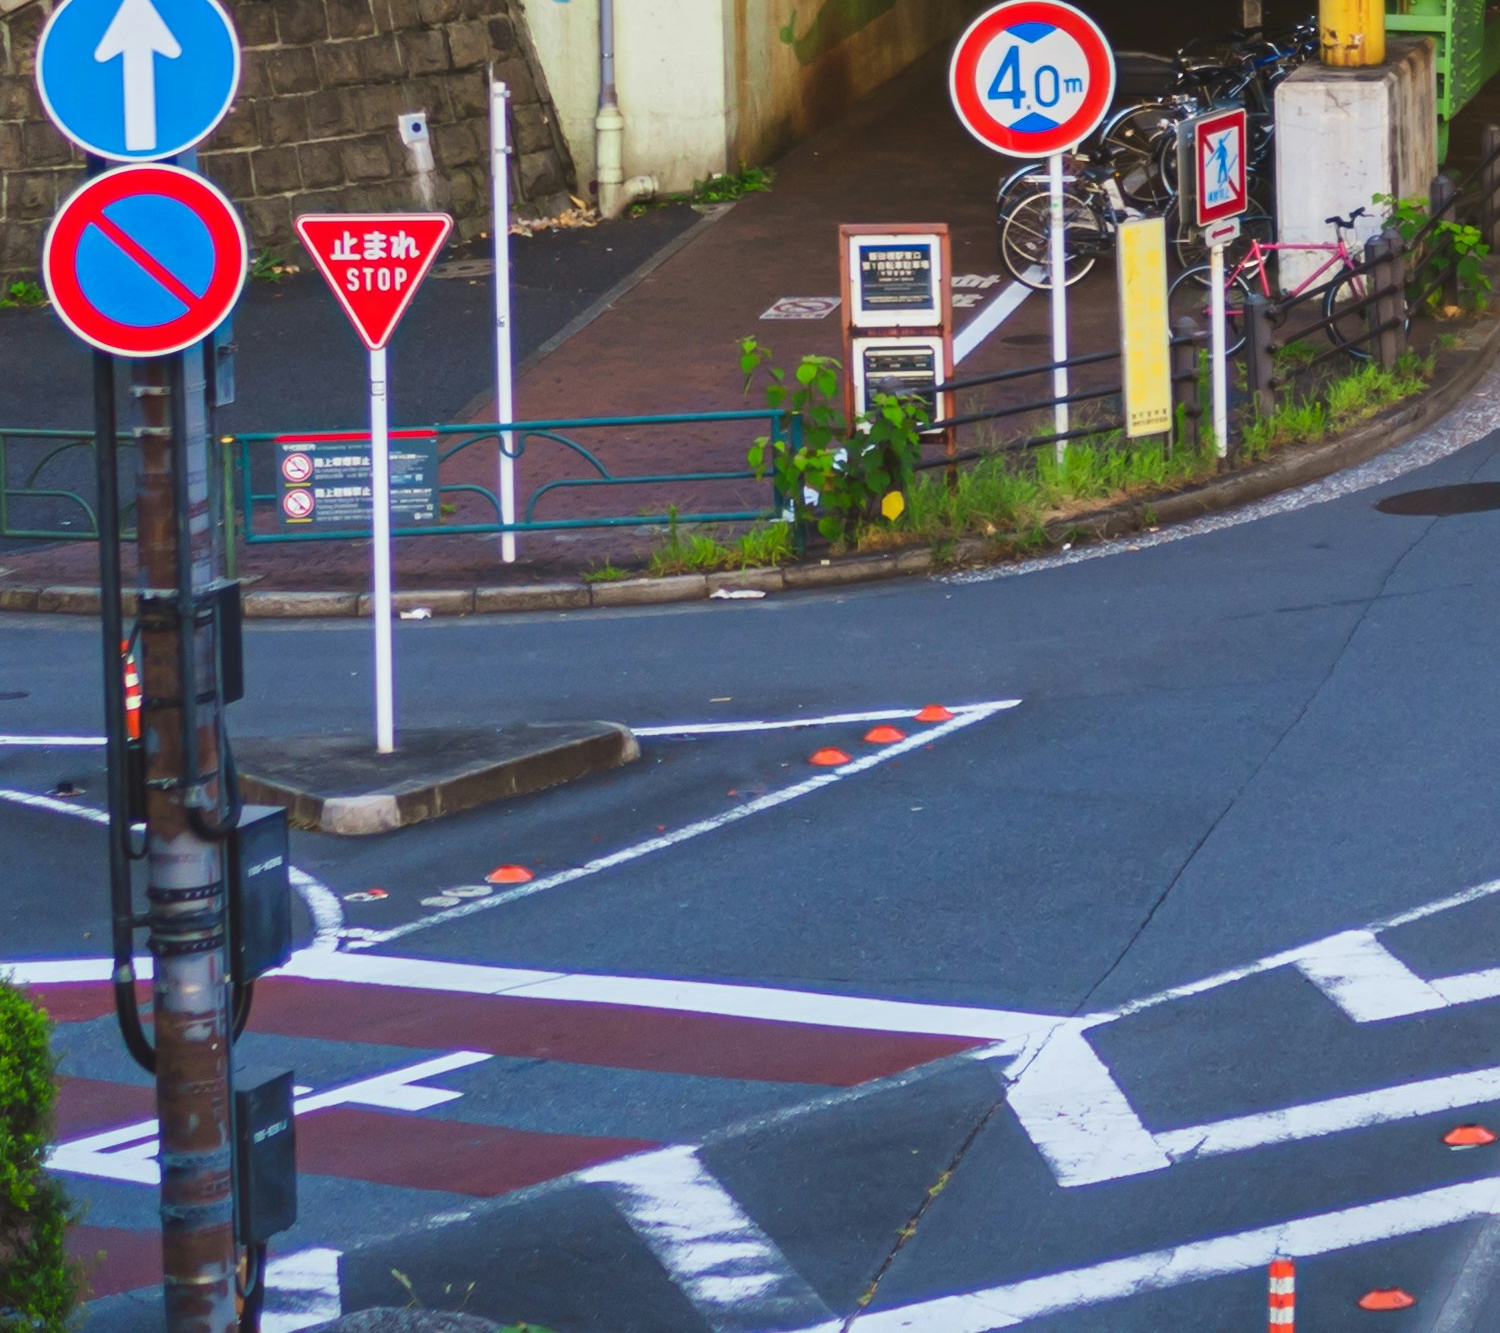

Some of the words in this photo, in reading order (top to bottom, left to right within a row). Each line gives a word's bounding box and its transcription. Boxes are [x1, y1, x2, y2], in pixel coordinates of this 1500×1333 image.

[329, 229, 421, 261] 止まれ
[345, 267, 408, 292] STOP
